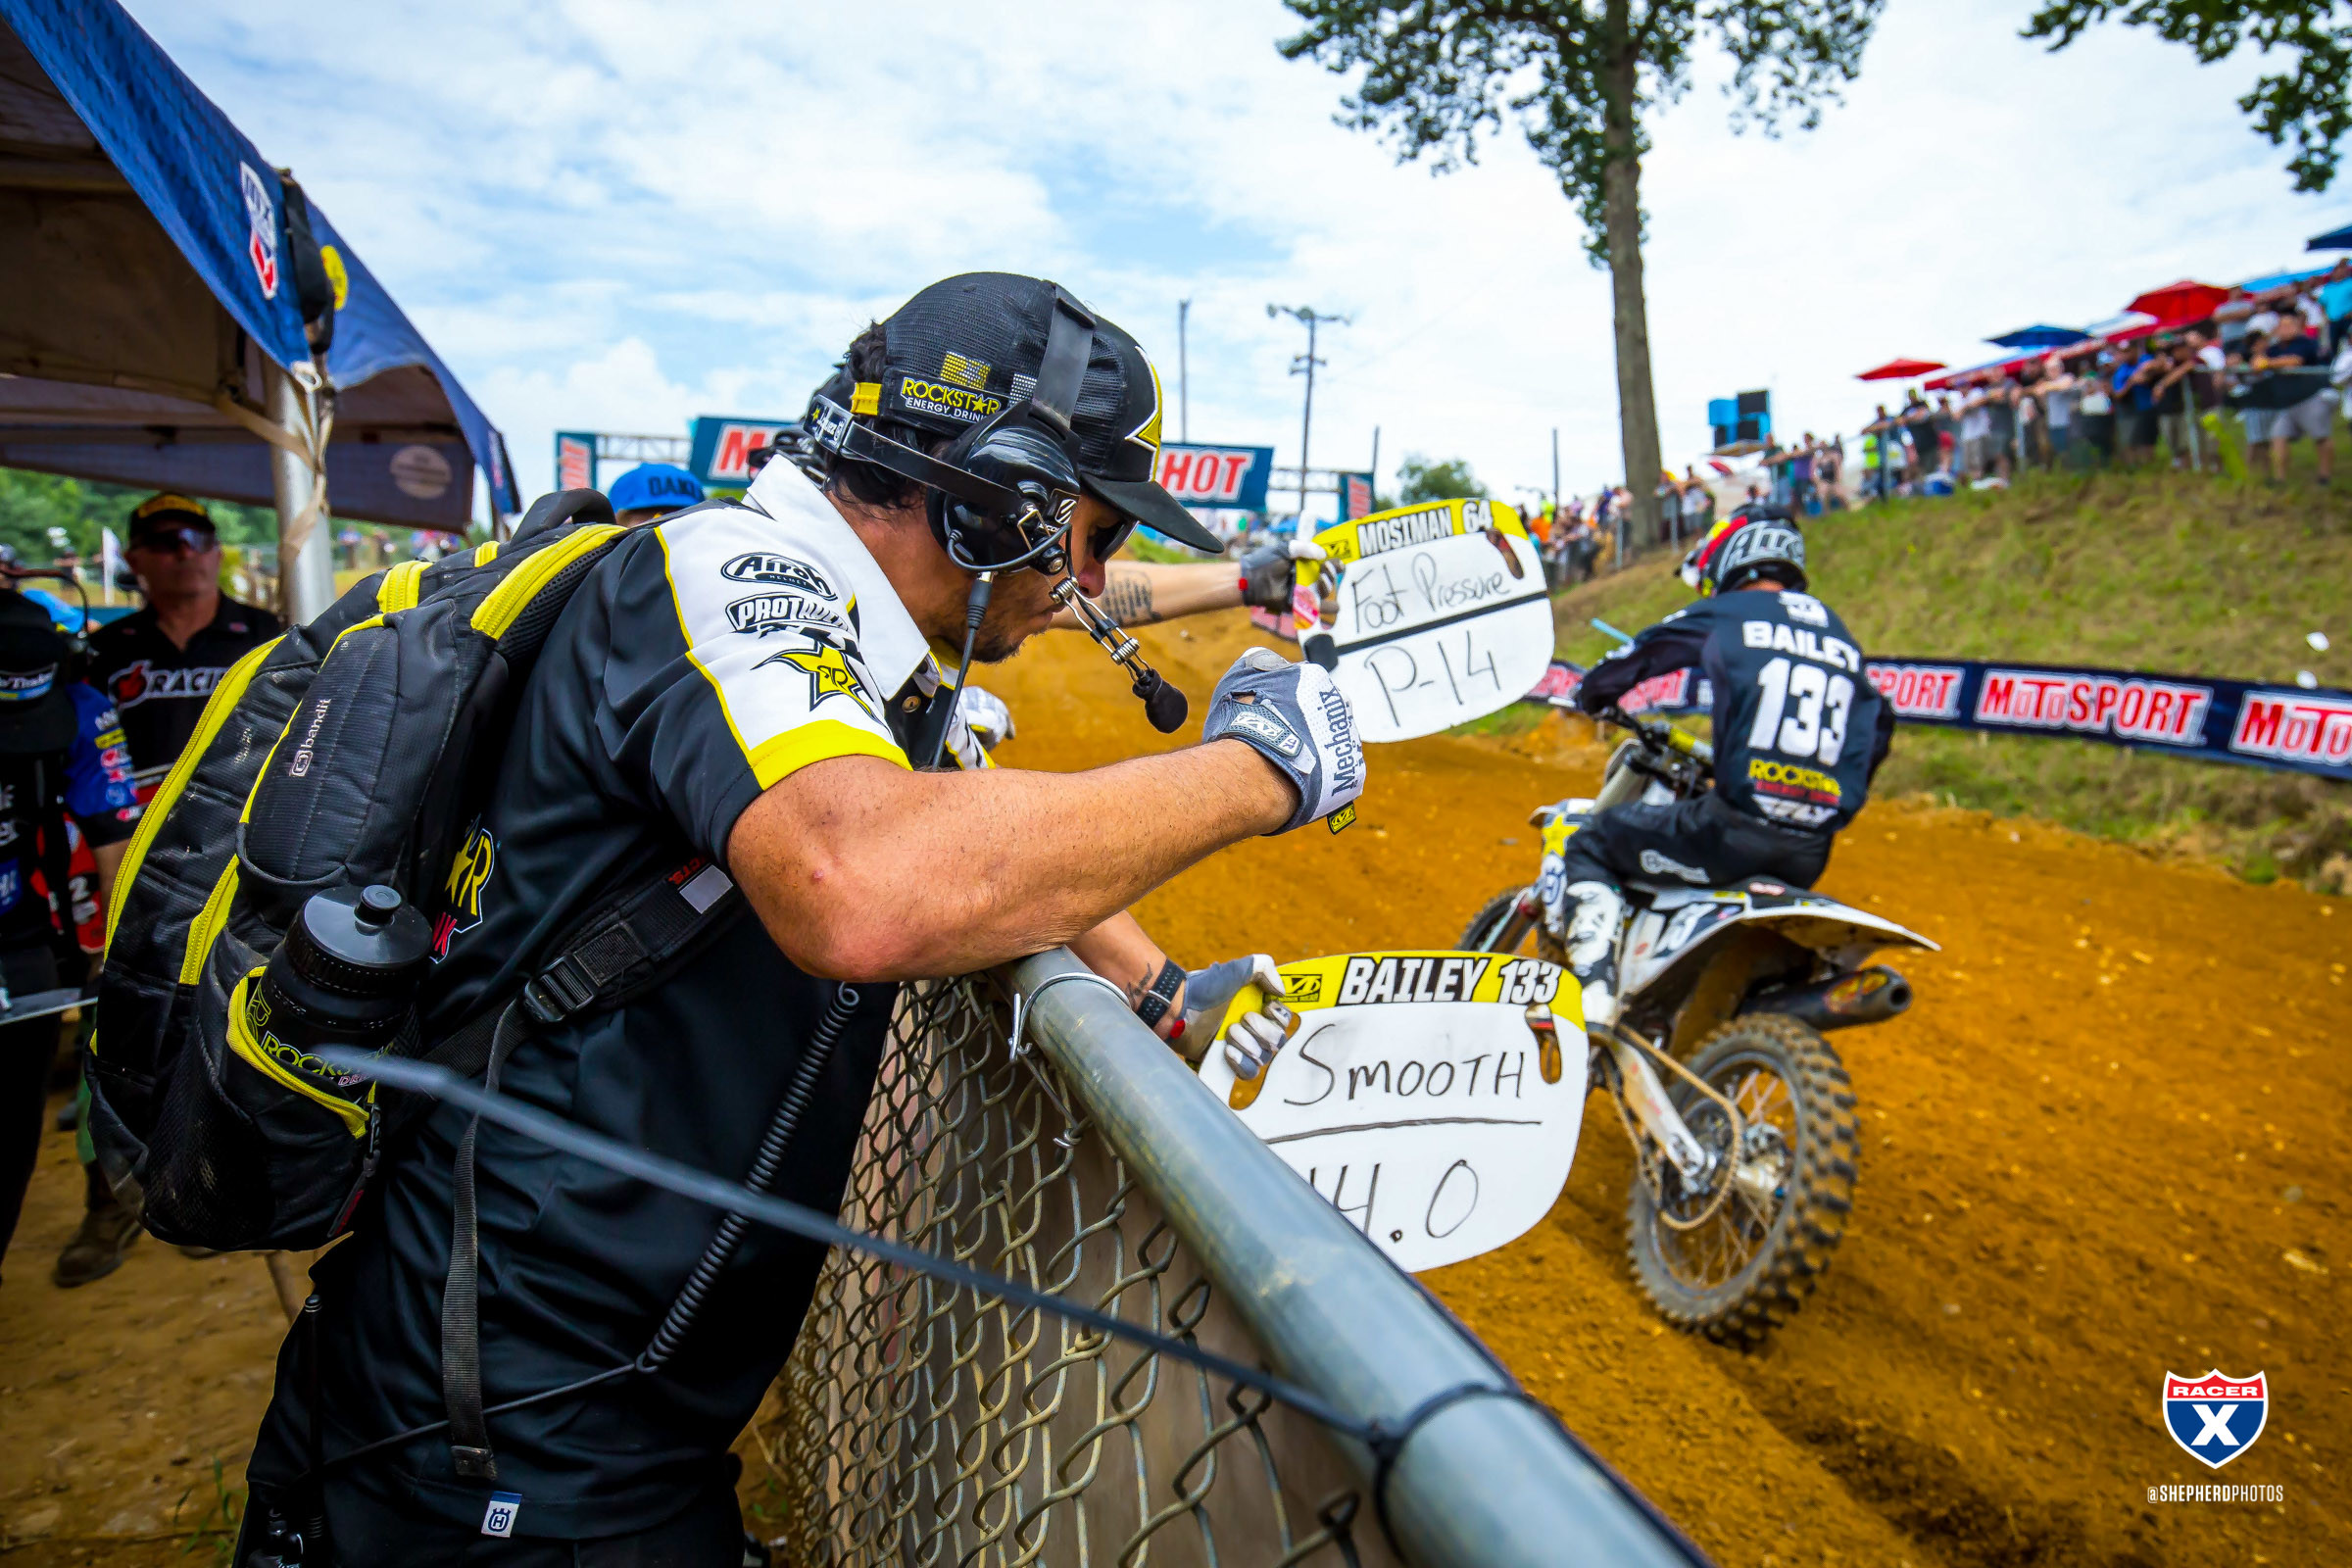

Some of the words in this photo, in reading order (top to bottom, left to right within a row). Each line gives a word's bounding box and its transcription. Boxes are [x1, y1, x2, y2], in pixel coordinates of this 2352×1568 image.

[907, 397, 950, 415] ENERGY
[1161, 451, 1248, 494] HOT
[1357, 507, 1454, 557] MOSIMAN
[1461, 501, 1493, 533] 64
[734, 557, 831, 595] Airoh
[769, 573, 808, 586] HELMET
[1351, 564, 1406, 633] Foot
[1412, 552, 1511, 612] Pressure
[1742, 620, 1860, 673] BAILEY
[1363, 629, 1501, 727] P-14
[300, 698, 332, 749] bandit
[1747, 657, 1855, 766] 133
[1318, 685, 1355, 797] Mechanix
[1338, 957, 1489, 1005] BAILEY
[1497, 958, 1563, 1004] 133
